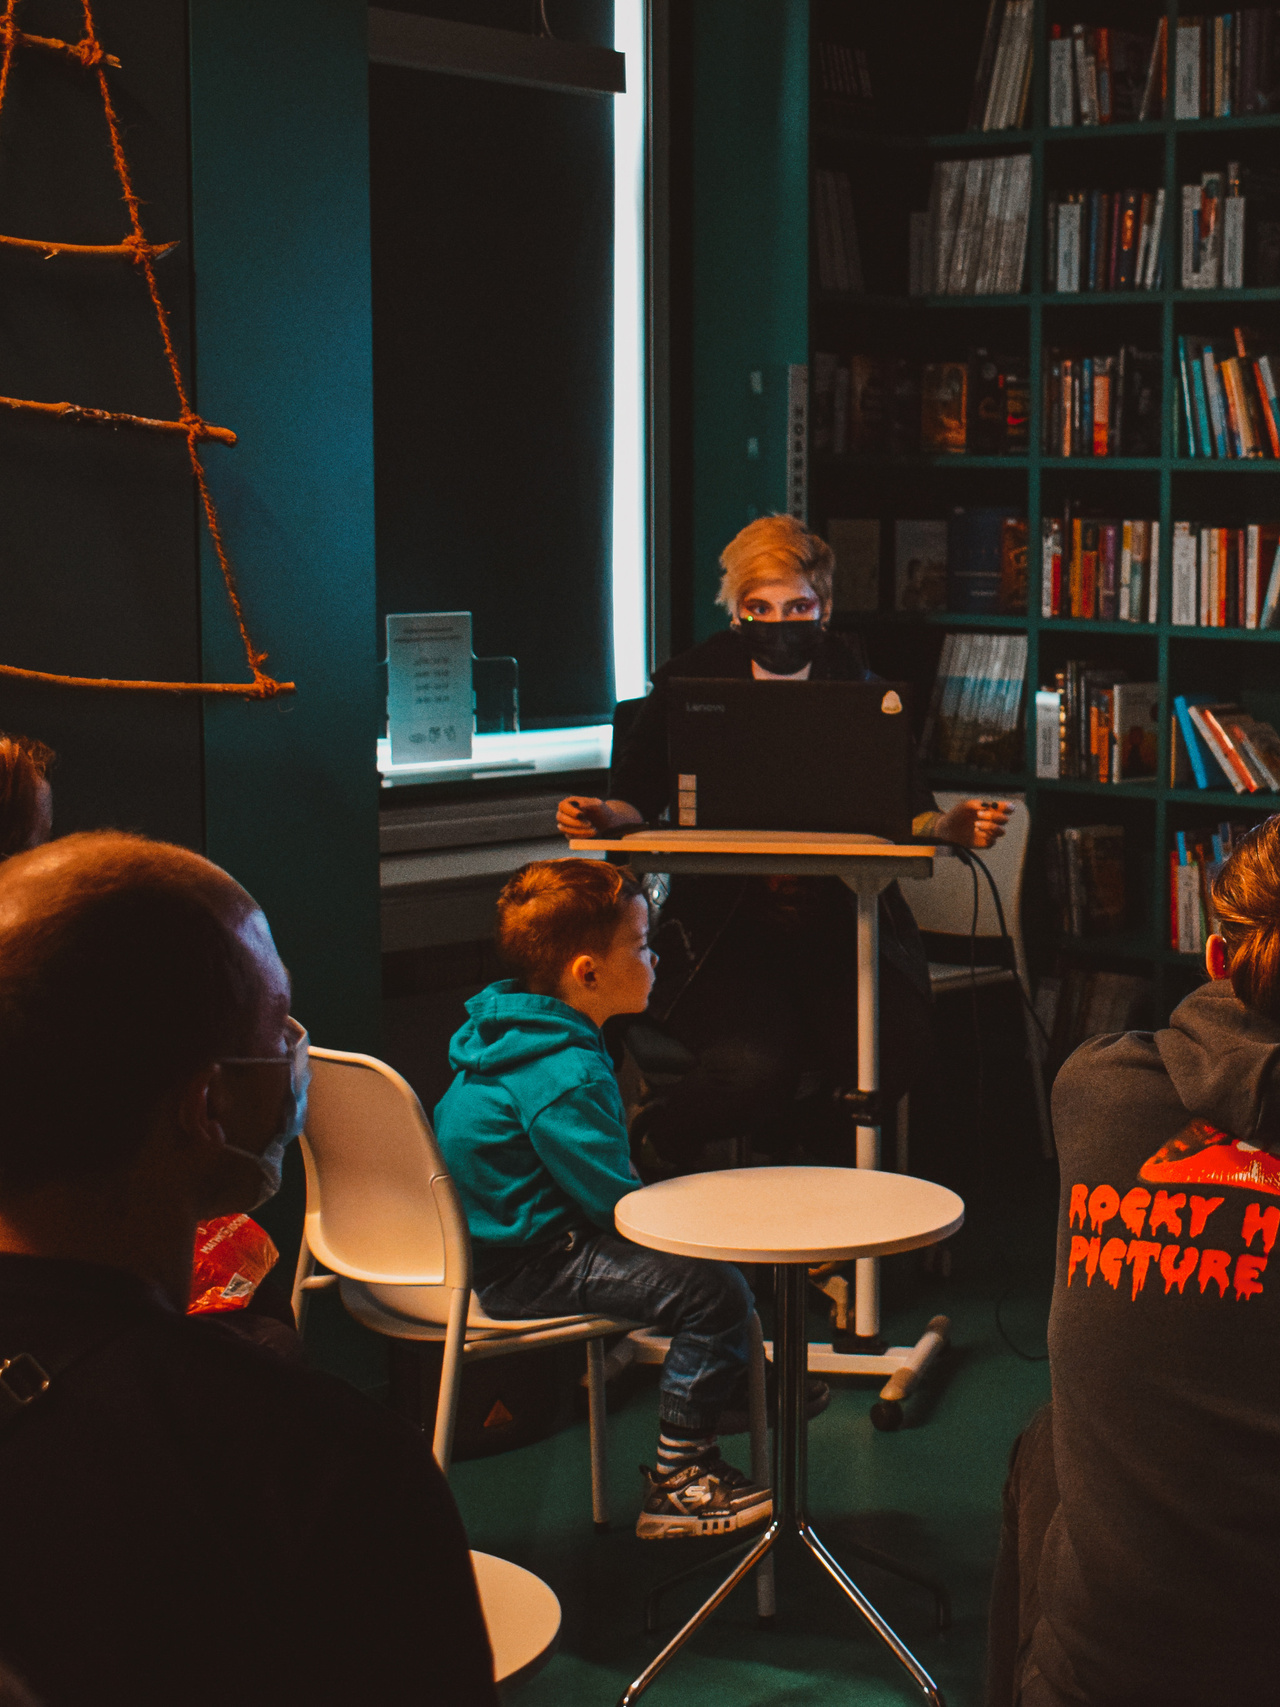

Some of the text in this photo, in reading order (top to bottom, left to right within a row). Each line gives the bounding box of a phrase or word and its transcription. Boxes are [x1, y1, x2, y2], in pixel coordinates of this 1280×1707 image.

[685, 701, 726, 714] Lenovo
[1068, 1183, 1225, 1238] ROCKY
[1067, 1235, 1269, 1302] PICTURE
